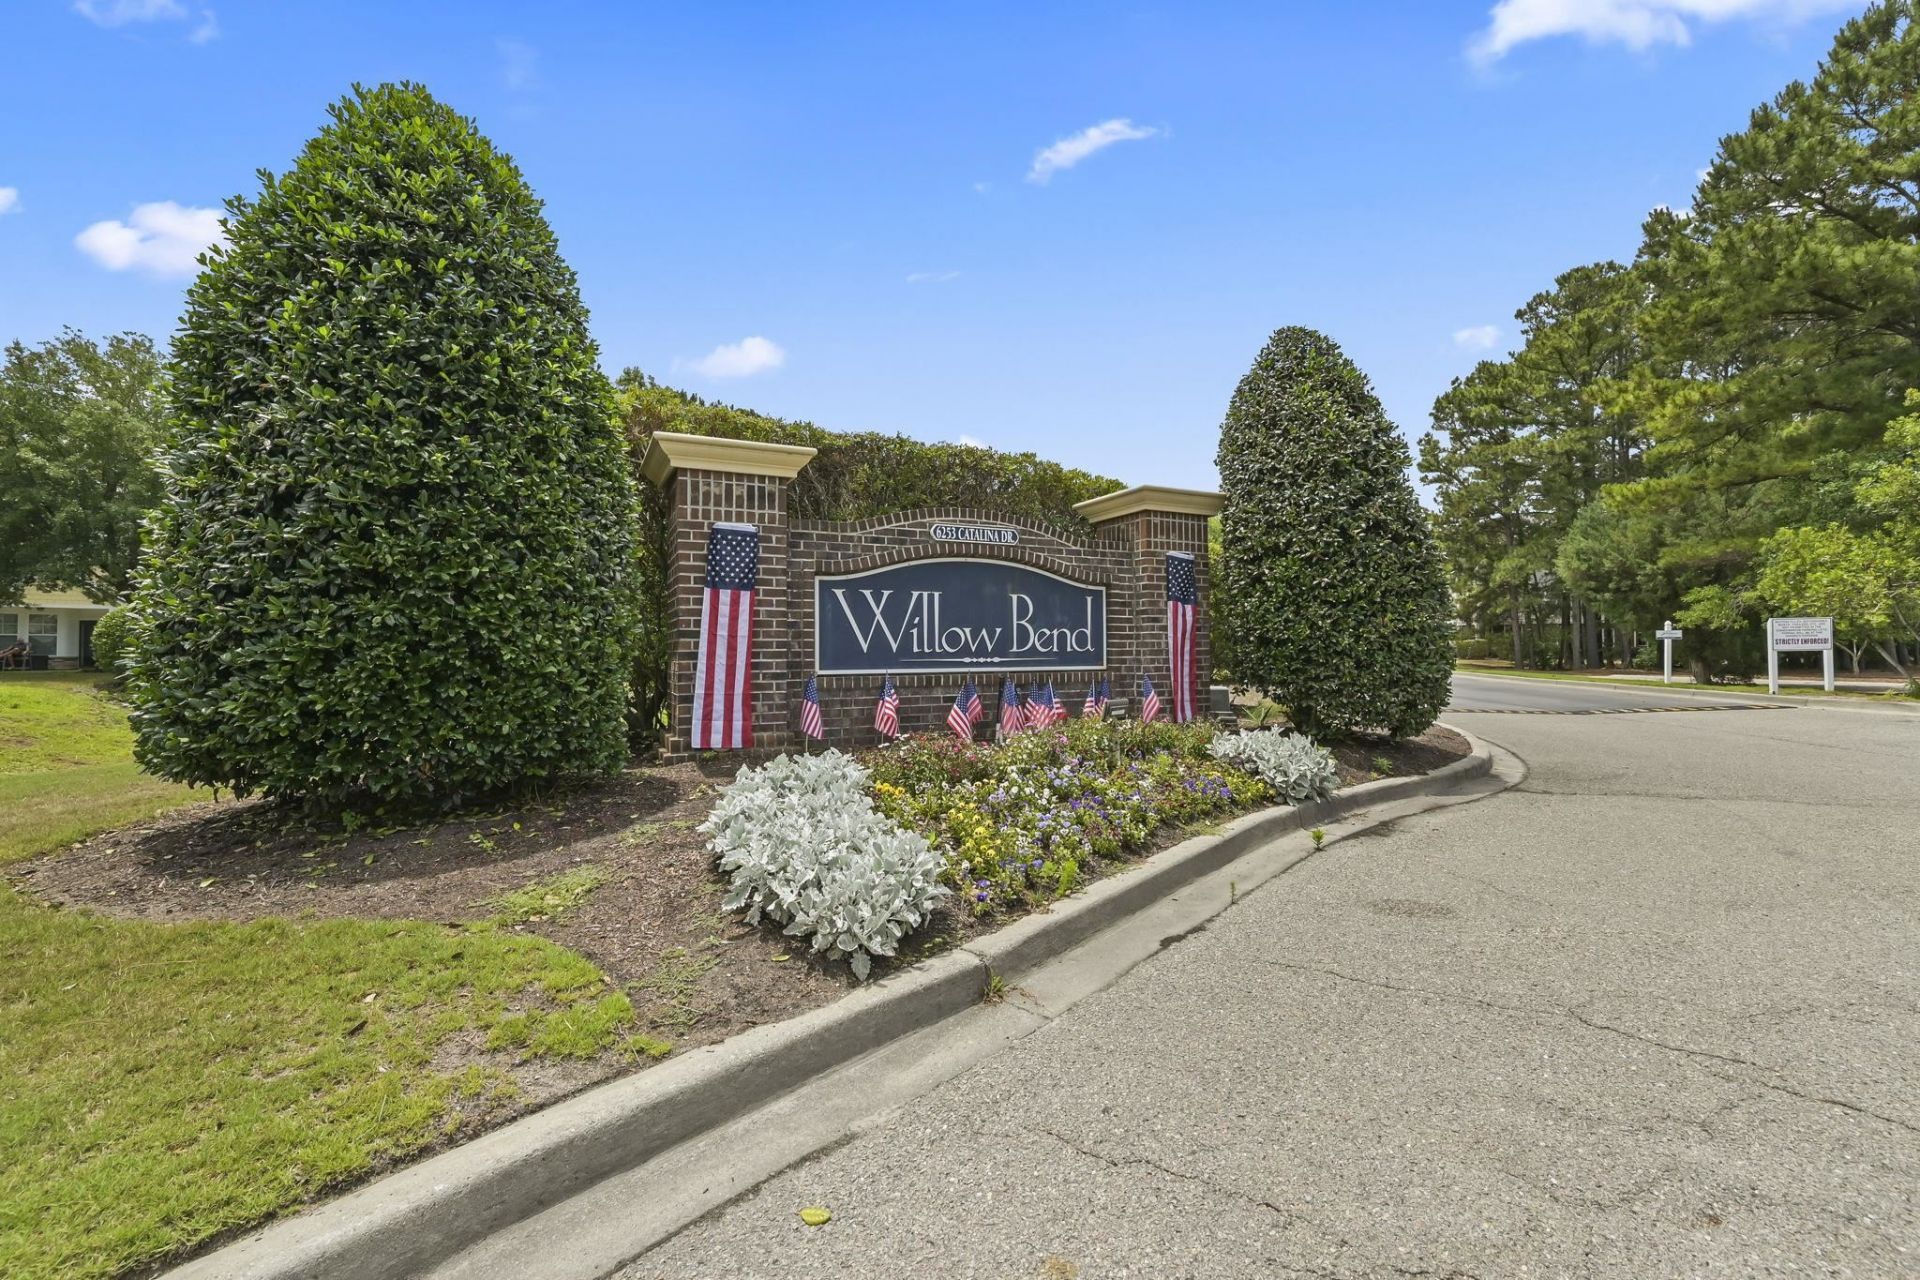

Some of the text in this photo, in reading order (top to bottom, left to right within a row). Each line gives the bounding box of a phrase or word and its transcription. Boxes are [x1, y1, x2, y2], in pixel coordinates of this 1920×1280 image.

[936, 526, 956, 539] 6253
[958, 528, 999, 541] CATALINA
[832, 588, 1095, 654] Willow Bend
